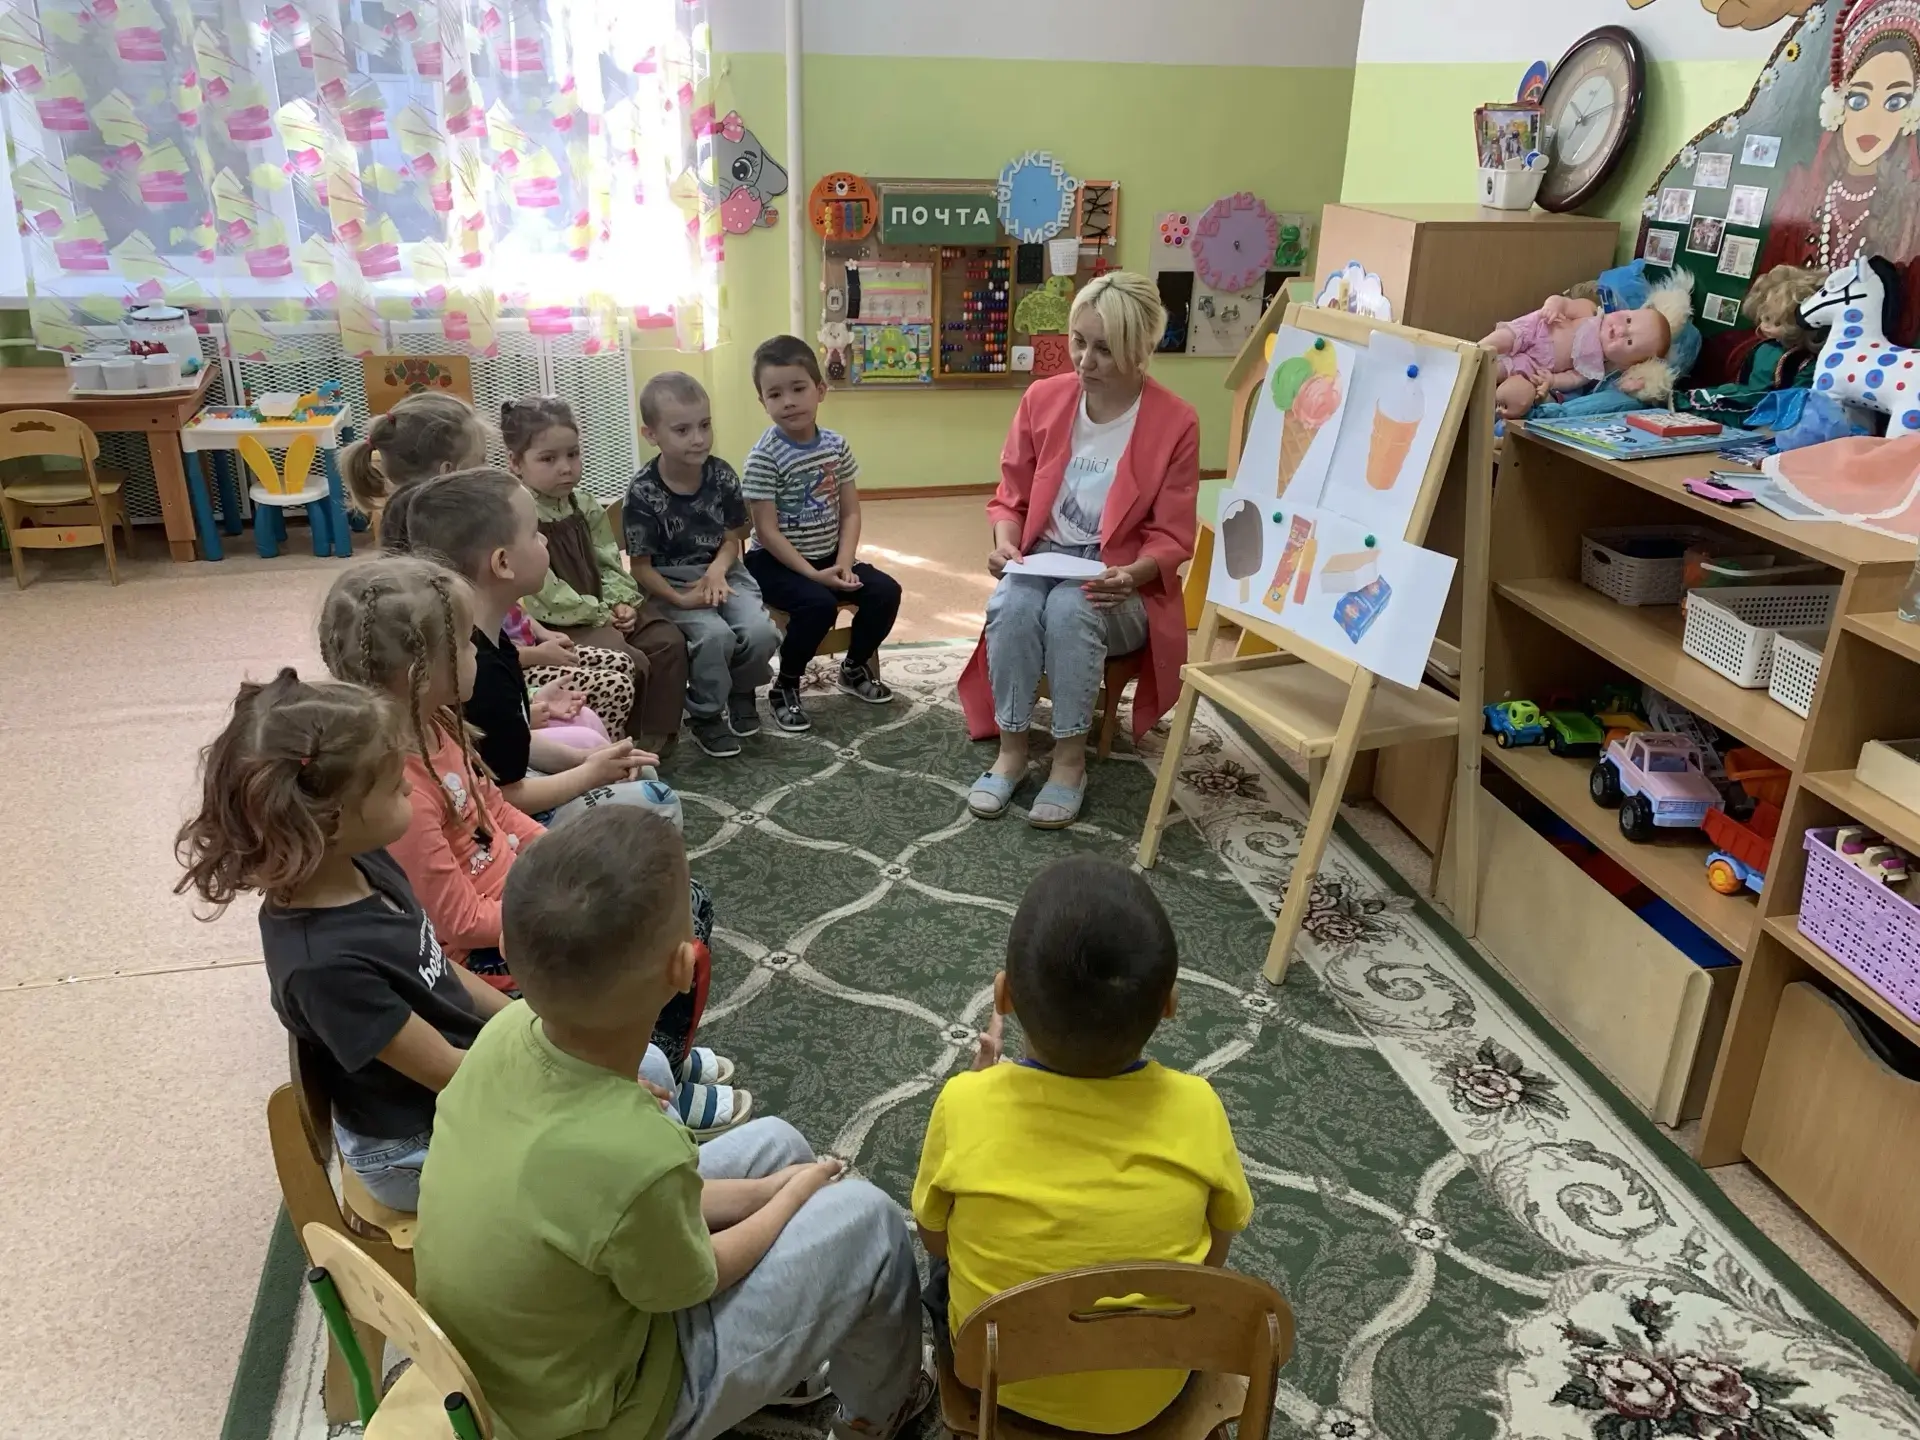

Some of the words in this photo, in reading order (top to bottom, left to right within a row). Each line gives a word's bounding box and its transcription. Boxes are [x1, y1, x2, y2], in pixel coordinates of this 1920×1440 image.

[1596, 46, 1611, 66] 12
[1011, 157, 1024, 174] У
[1024, 150, 1039, 167] К
[1039, 151, 1052, 167] Е
[1051, 160, 1064, 176] Б
[999, 170, 1013, 189] Ц
[1057, 176, 1078, 192] Ю
[1062, 193, 1075, 208] В
[1234, 192, 1255, 210] 12
[1257, 199, 1266, 217] 1
[891, 206, 991, 226] ПОЧТА
[1005, 219, 1019, 235] Н
[1197, 217, 1219, 237] 10
[1023, 228, 1043, 244] М
[1073, 456, 1109, 474] mid
